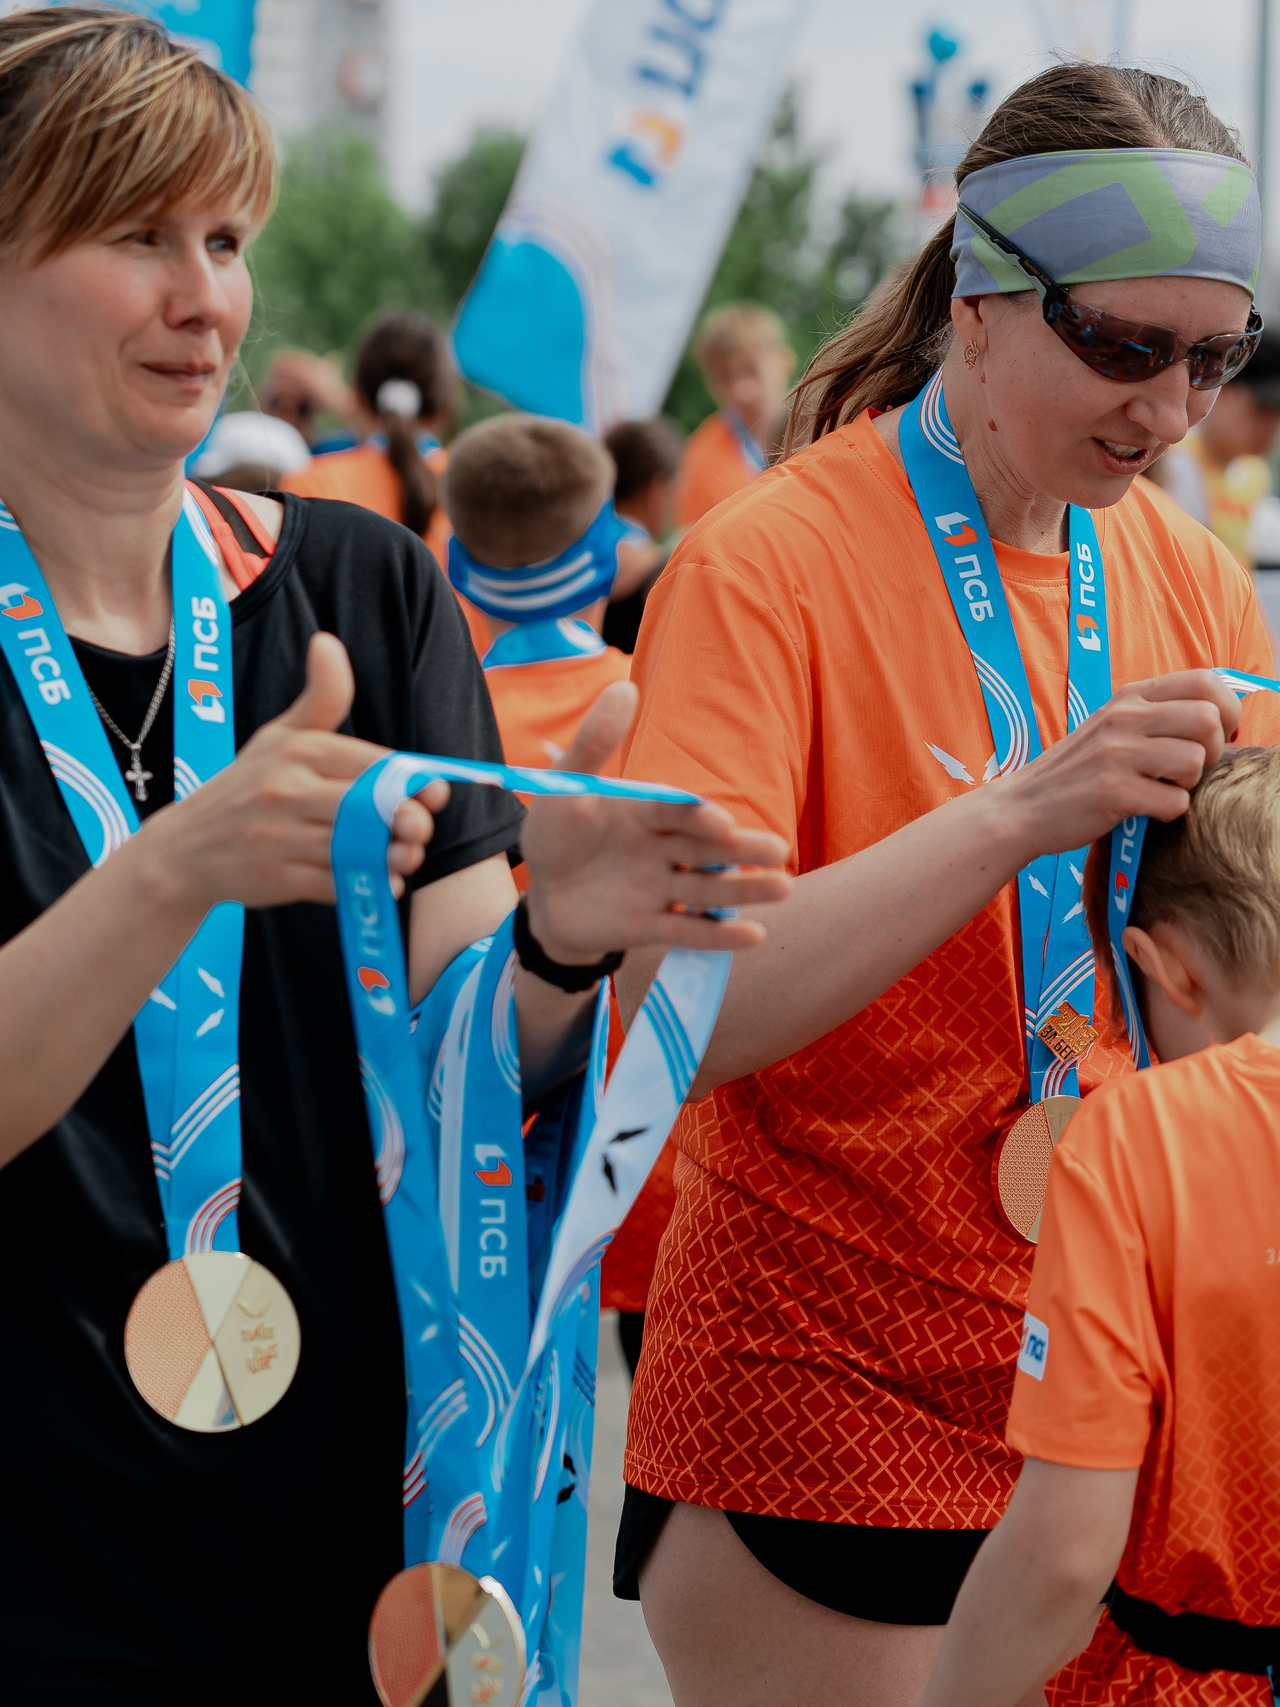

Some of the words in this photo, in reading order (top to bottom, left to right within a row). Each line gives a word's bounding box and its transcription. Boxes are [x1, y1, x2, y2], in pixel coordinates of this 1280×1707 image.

[954, 554, 995, 622] ПСБ
[1077, 542, 1095, 607] ПСБ
[17, 627, 72, 706] ПСБ
[191, 596, 219, 672] ПСБ
[1120, 816, 1137, 864] ПС
[480, 1199, 507, 1279] ПСБ
[1025, 1333, 1045, 1362] ПС
